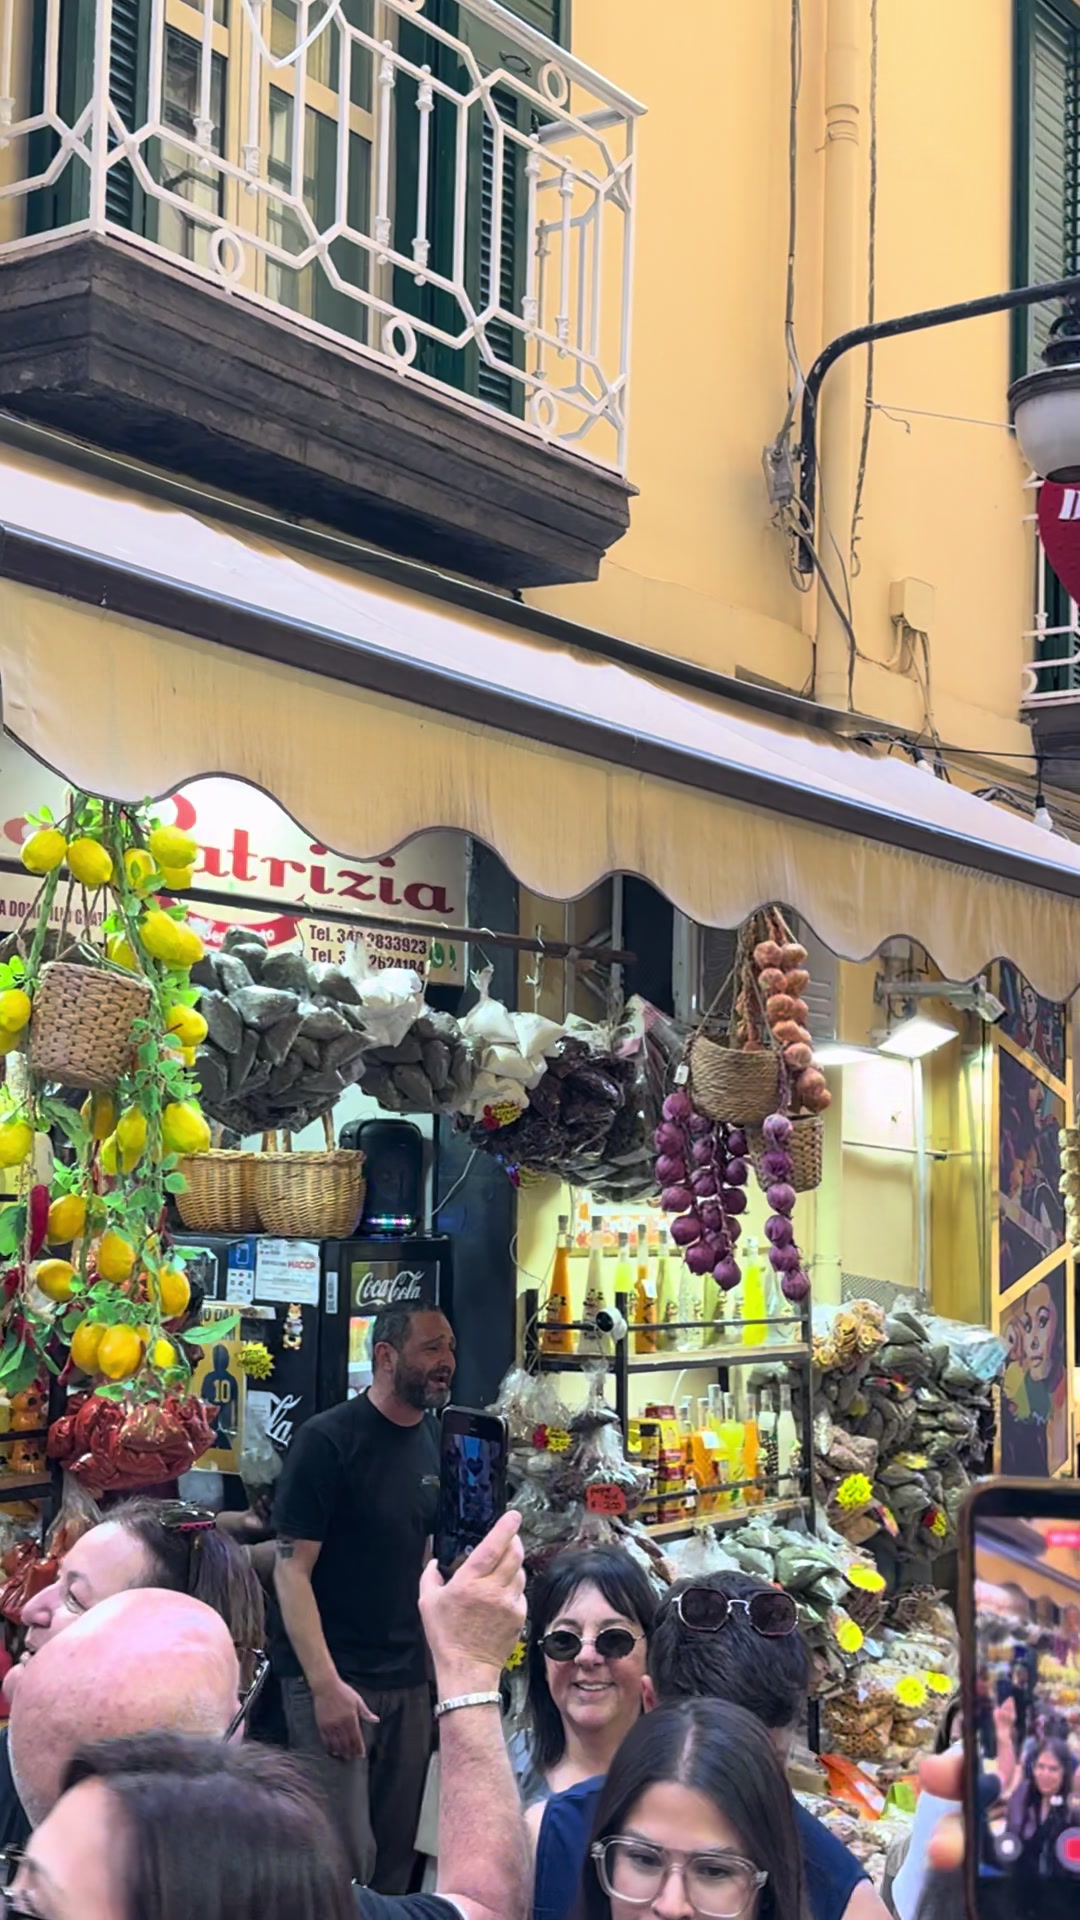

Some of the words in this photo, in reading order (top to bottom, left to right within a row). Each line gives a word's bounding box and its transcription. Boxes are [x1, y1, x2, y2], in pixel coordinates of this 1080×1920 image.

[9, 900, 72, 923] DOIILIO
[309, 924, 334, 942] Tel.
[367, 932, 427, 955] 2833923
[311, 947, 334, 964] Tel.
[213, 1379, 231, 1403] 10
